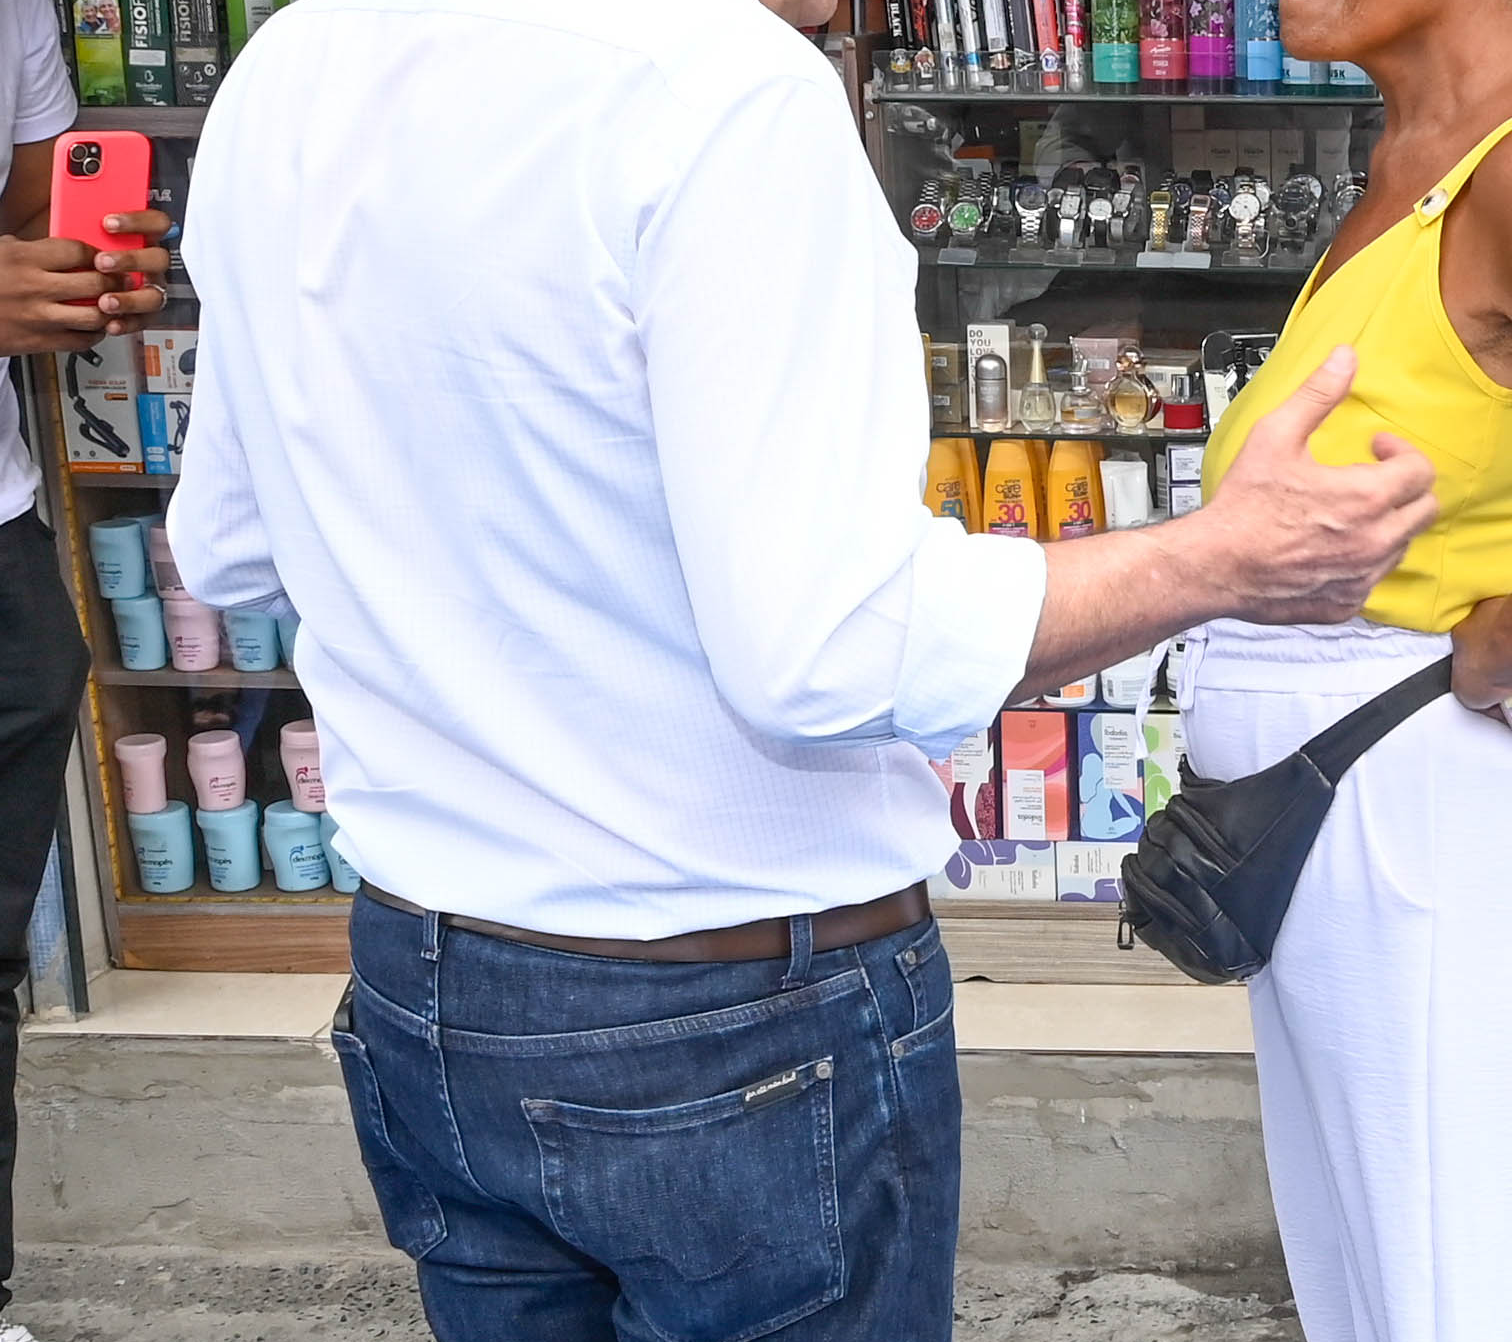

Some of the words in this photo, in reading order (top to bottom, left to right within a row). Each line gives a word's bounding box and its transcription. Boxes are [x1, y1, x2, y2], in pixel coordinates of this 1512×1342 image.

[995, 483, 1021, 494] care
[998, 504, 1025, 523] 30
[1069, 501, 1091, 523] 30
